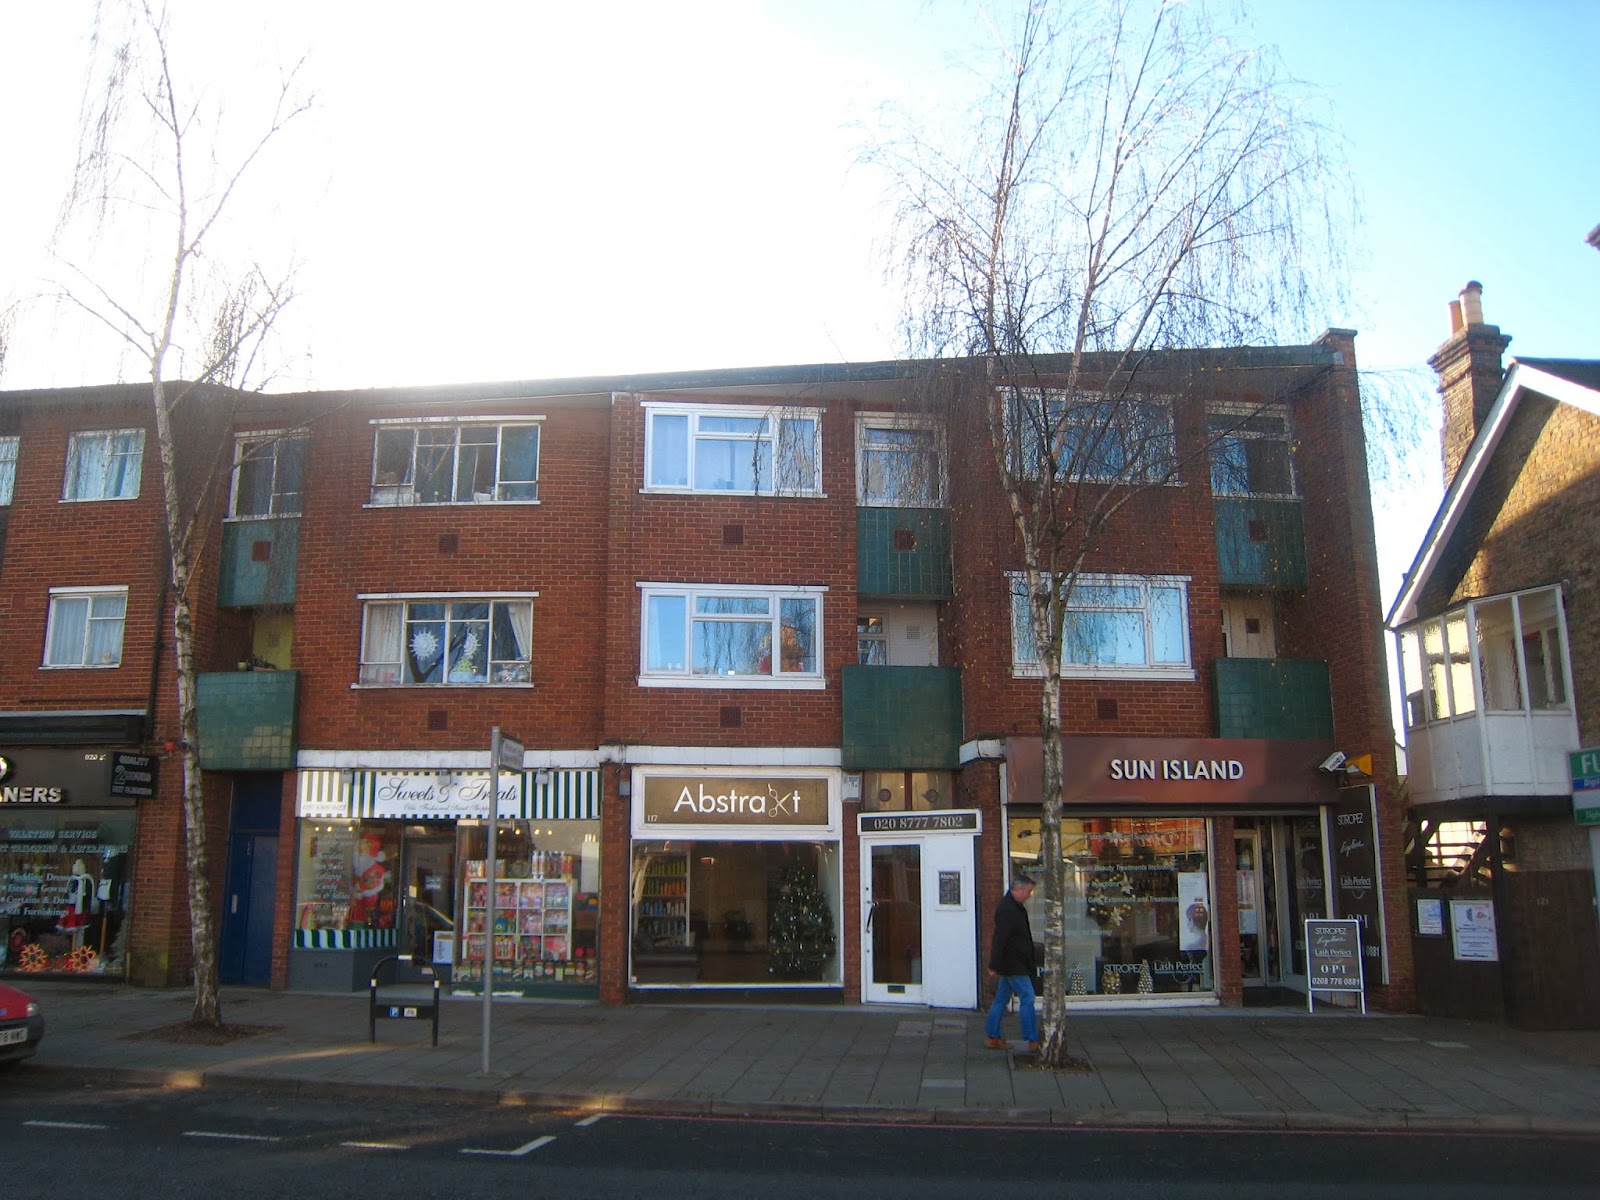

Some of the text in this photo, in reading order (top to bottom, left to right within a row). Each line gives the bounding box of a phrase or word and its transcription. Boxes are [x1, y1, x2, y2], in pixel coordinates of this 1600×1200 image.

[119, 755, 150, 767] QUALITY
[114, 765, 126, 785] 2
[1110, 759, 1244, 780] SUN ISLAND
[0, 786, 62, 803] NERS
[378, 777, 517, 804] Sweets & Trats
[647, 814, 658, 822] 117
[874, 815, 963, 830] 020 8777 7802
[58, 829, 98, 839] SERVICE
[9, 873, 73, 884] Wedding Dress
[1153, 960, 1174, 971] Lash
[1312, 977, 1329, 985] 0208
[1330, 977, 1343, 985] 776
